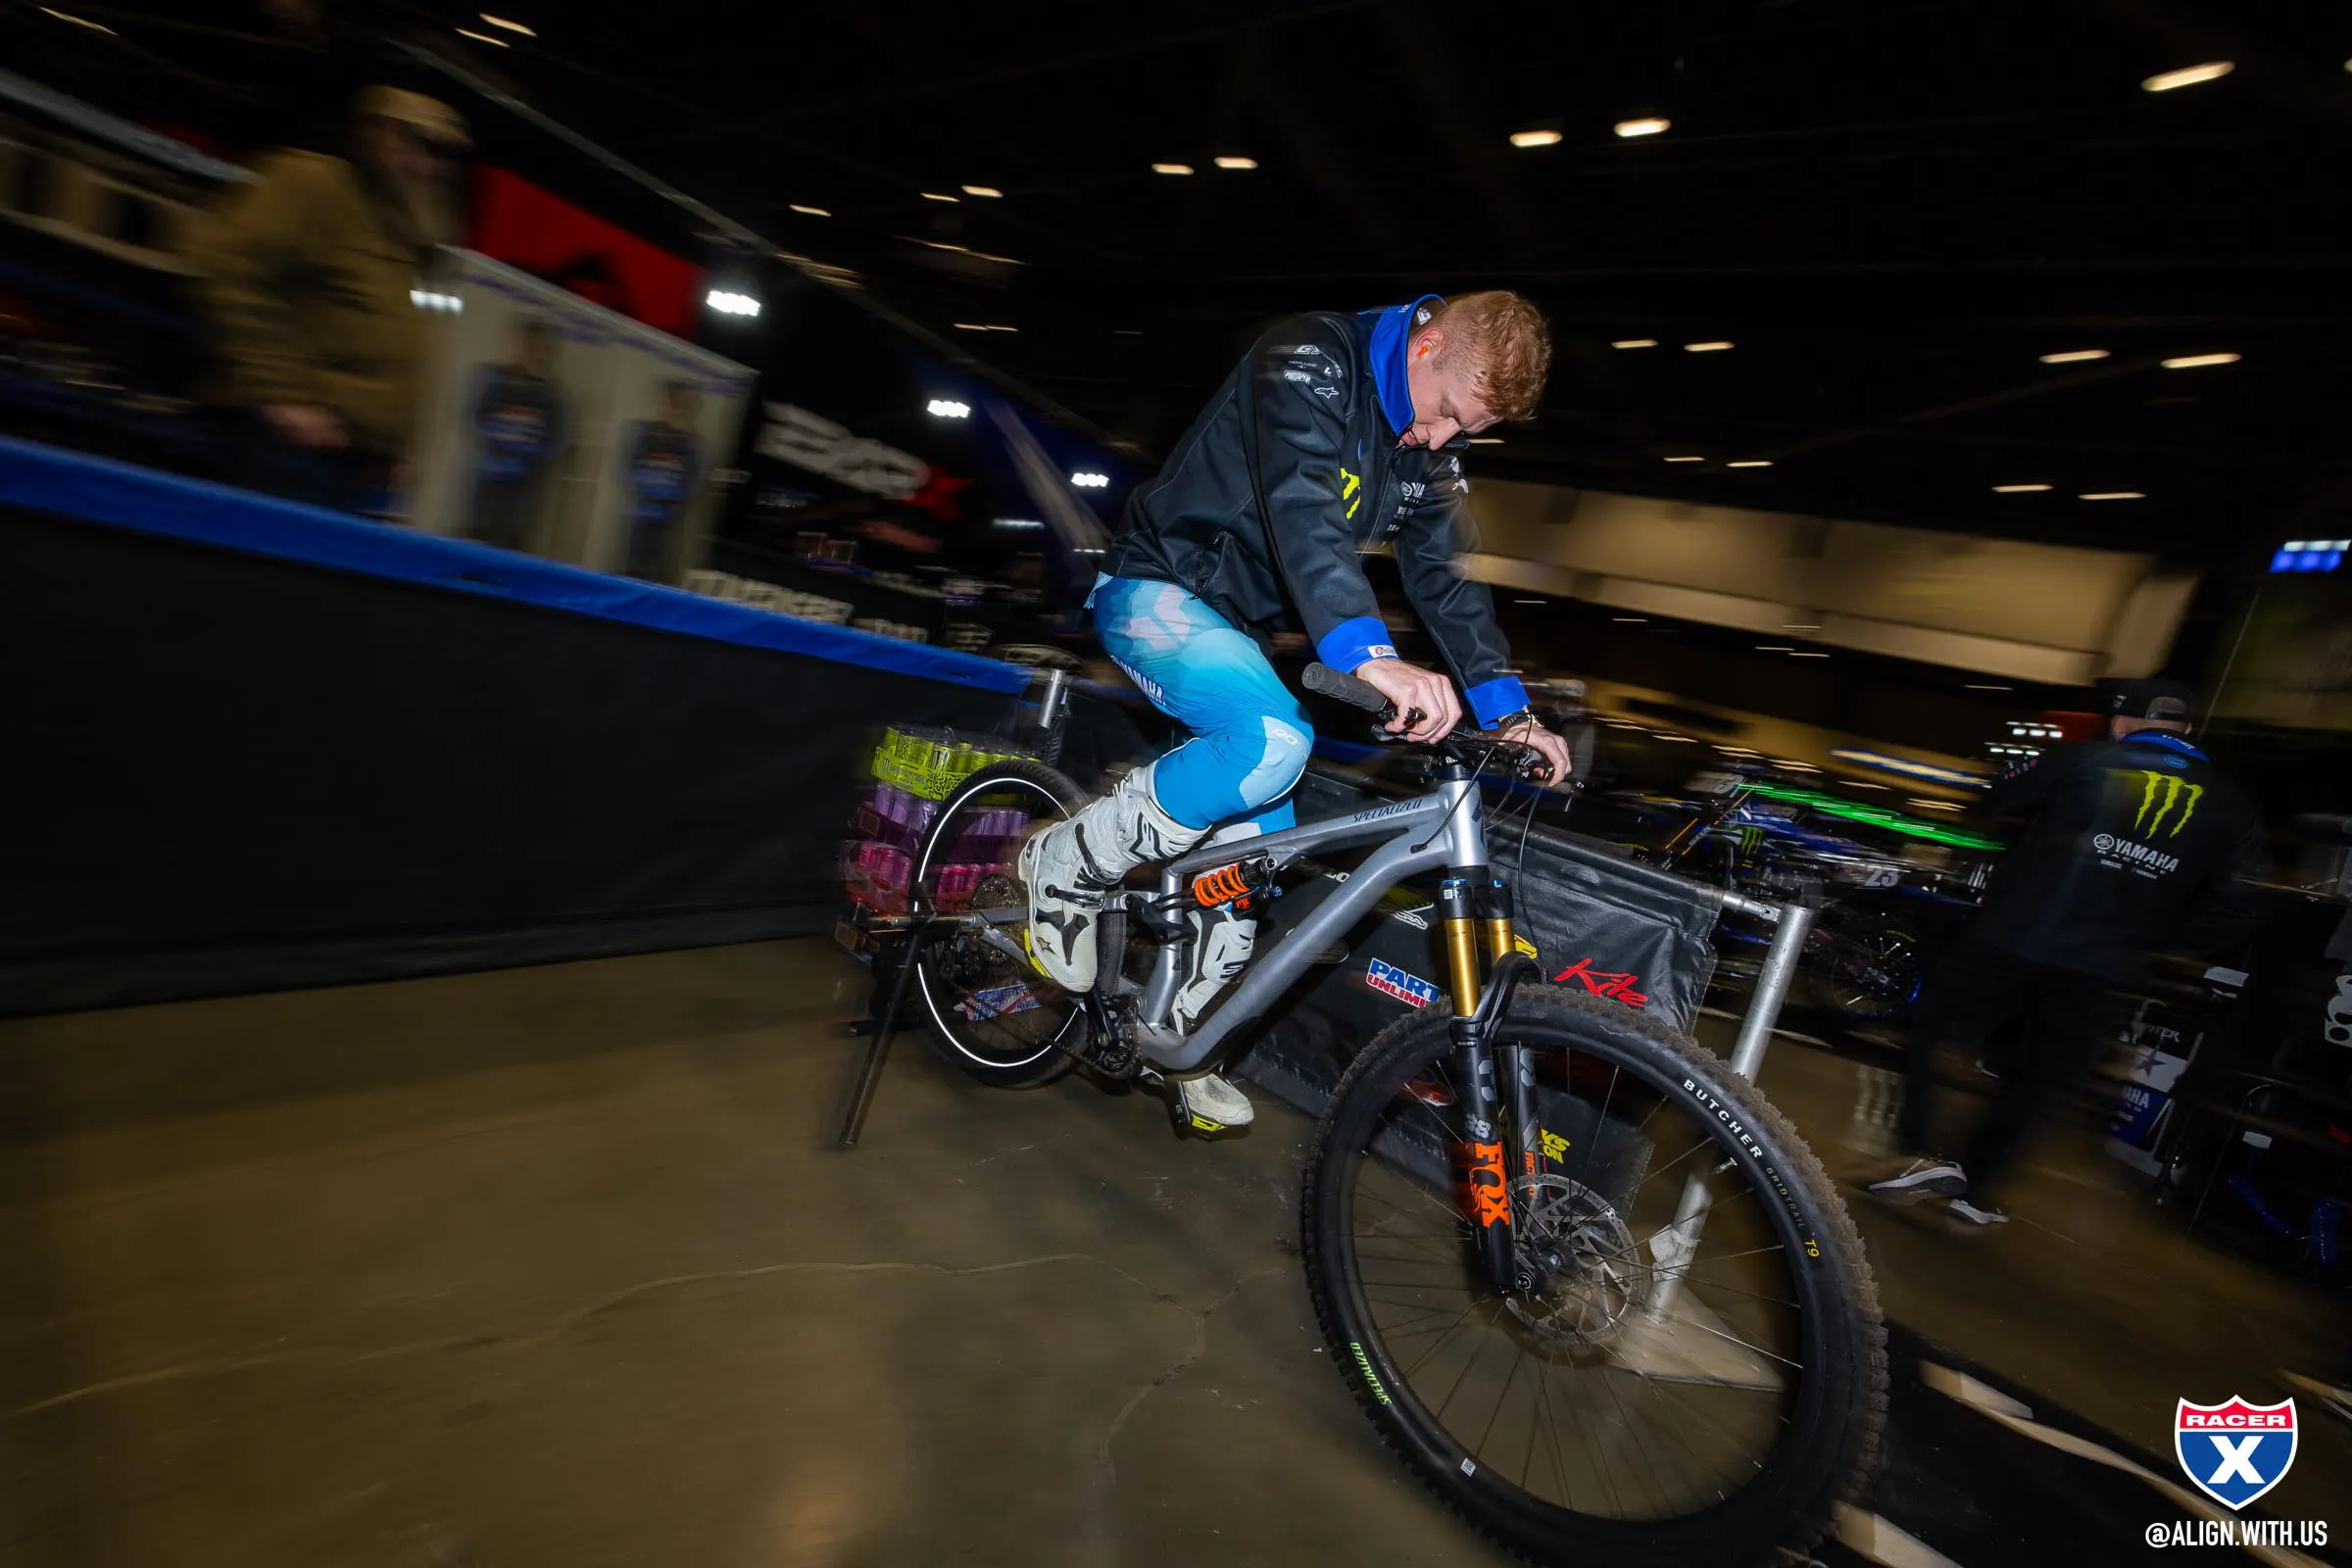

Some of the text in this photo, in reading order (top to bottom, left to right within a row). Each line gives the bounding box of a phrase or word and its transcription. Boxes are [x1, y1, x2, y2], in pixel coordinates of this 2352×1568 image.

[1352, 800, 1423, 823] SPECIALIZED
[2115, 838, 2180, 872] YAMAHA
[1367, 973, 1427, 1007] UNLIMI
[1370, 957, 1440, 1002] PART
[1469, 1140, 1510, 1228] FOX
[1684, 1079, 1763, 1158] BUTCHER
[1804, 1239, 1820, 1257] T9
[1349, 1342, 1392, 1405] SPECIALIZED
